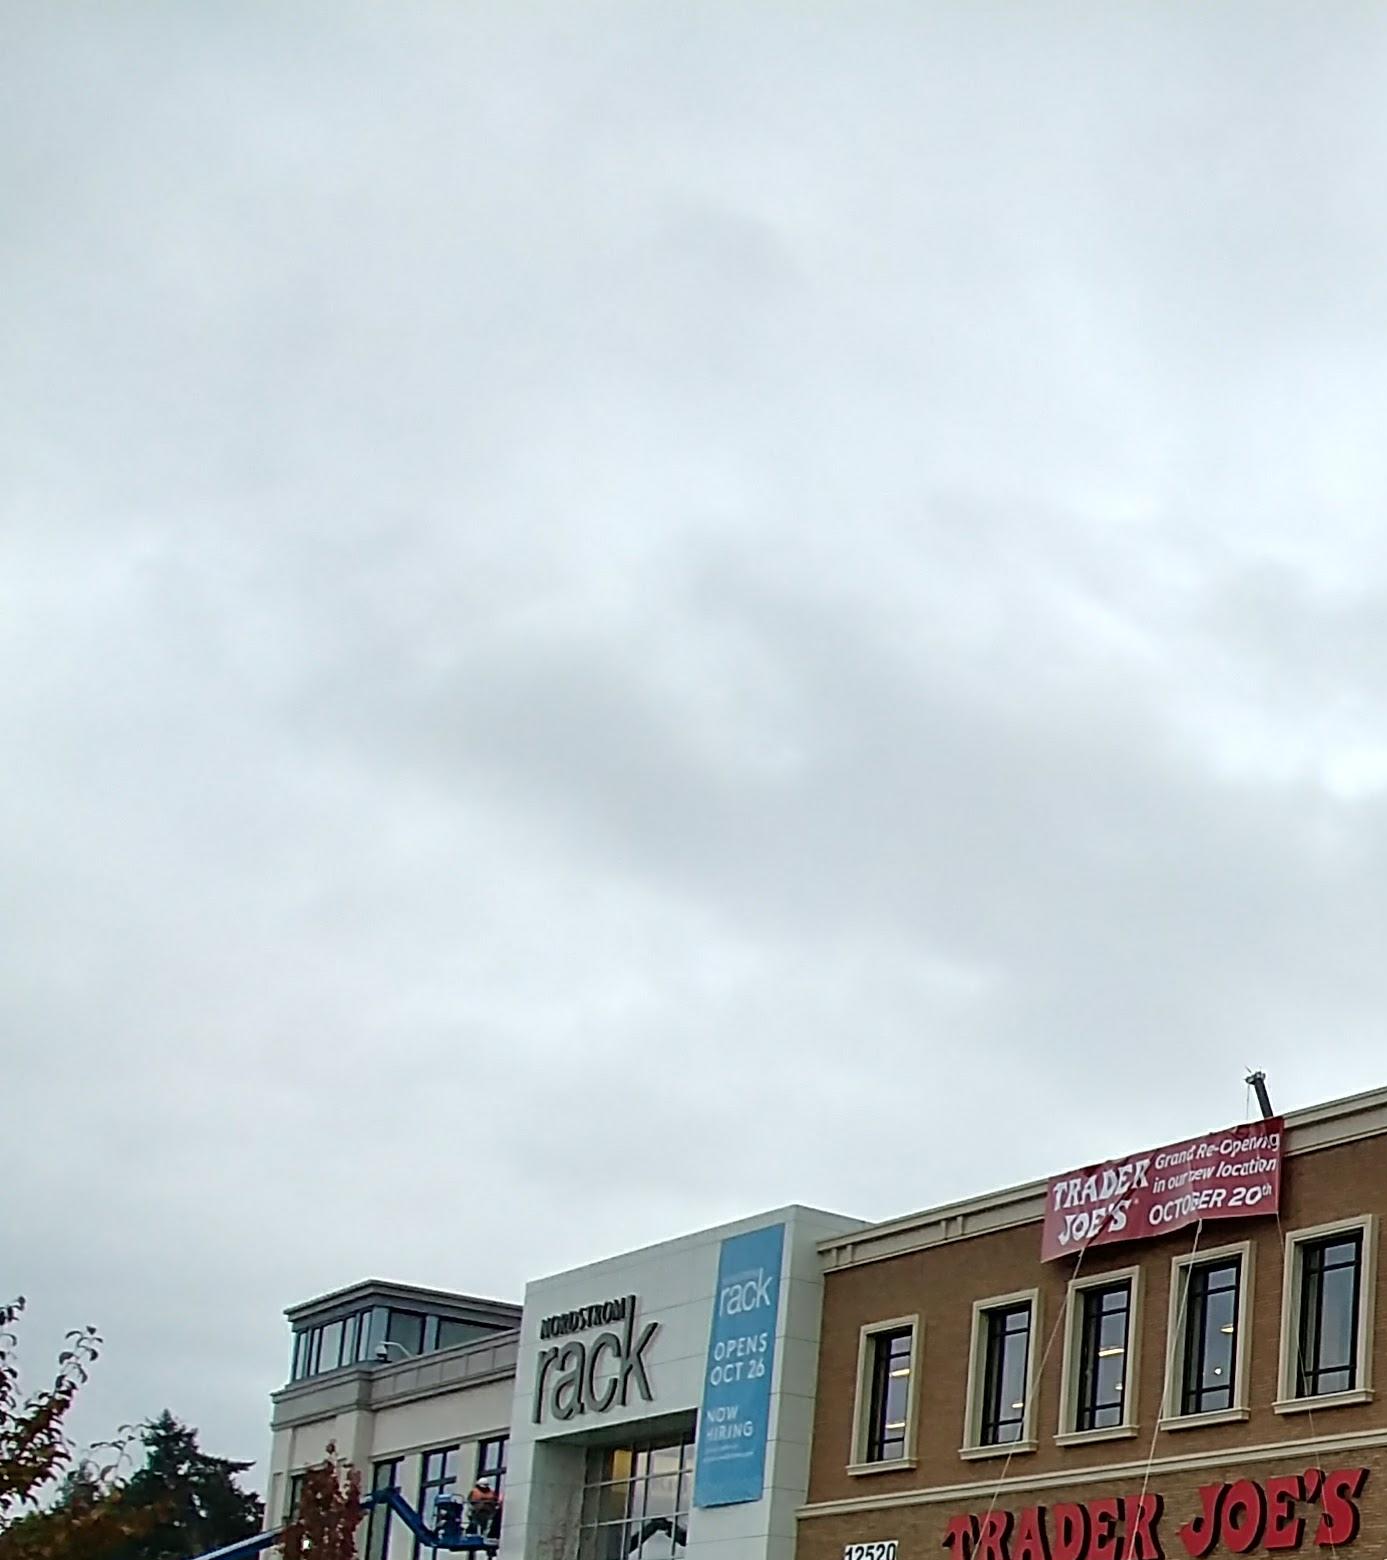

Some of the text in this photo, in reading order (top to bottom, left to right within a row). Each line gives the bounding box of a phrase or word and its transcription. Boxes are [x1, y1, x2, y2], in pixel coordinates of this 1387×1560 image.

[1155, 1133, 1280, 1170] Grand Re-Opening
[1053, 1159, 1150, 1212] TRADER
[1153, 1156, 1277, 1194] in our new location
[1058, 1199, 1131, 1246] JOE'S
[1149, 1188, 1227, 1226] OCTOBER
[719, 1267, 773, 1317] rack
[540, 1297, 626, 1340] NORDSTROM
[532, 1294, 660, 1424] rack
[714, 1332, 768, 1361] OPENS
[710, 1357, 766, 1386] OCT 26
[706, 1405, 739, 1423] NOW
[706, 1420, 753, 1440] HIRING
[1176, 1467, 1371, 1560] JOE'S
